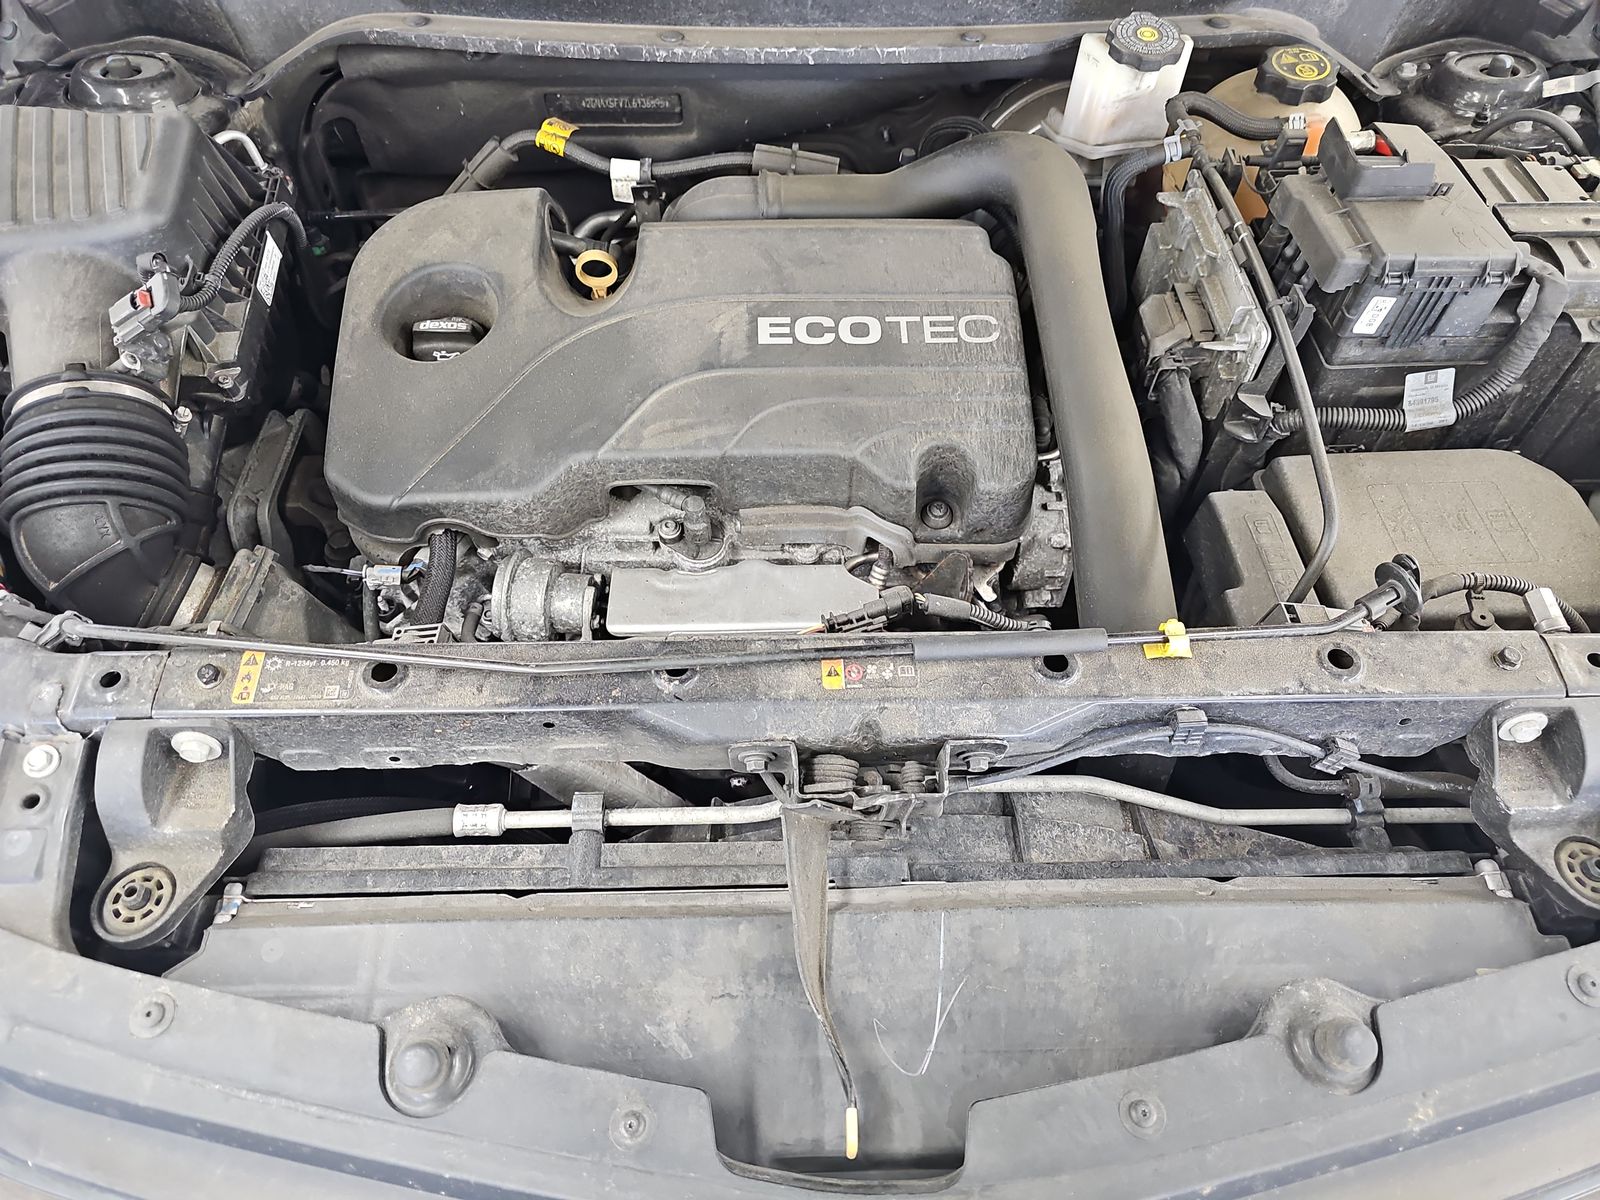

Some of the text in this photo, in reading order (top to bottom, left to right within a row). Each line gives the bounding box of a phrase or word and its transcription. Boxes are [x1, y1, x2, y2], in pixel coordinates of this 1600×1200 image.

[419, 320, 467, 330] dexos
[757, 314, 1000, 345] ECOTEC
[285, 659, 350, 667] R-1234yf 0.450 kg
